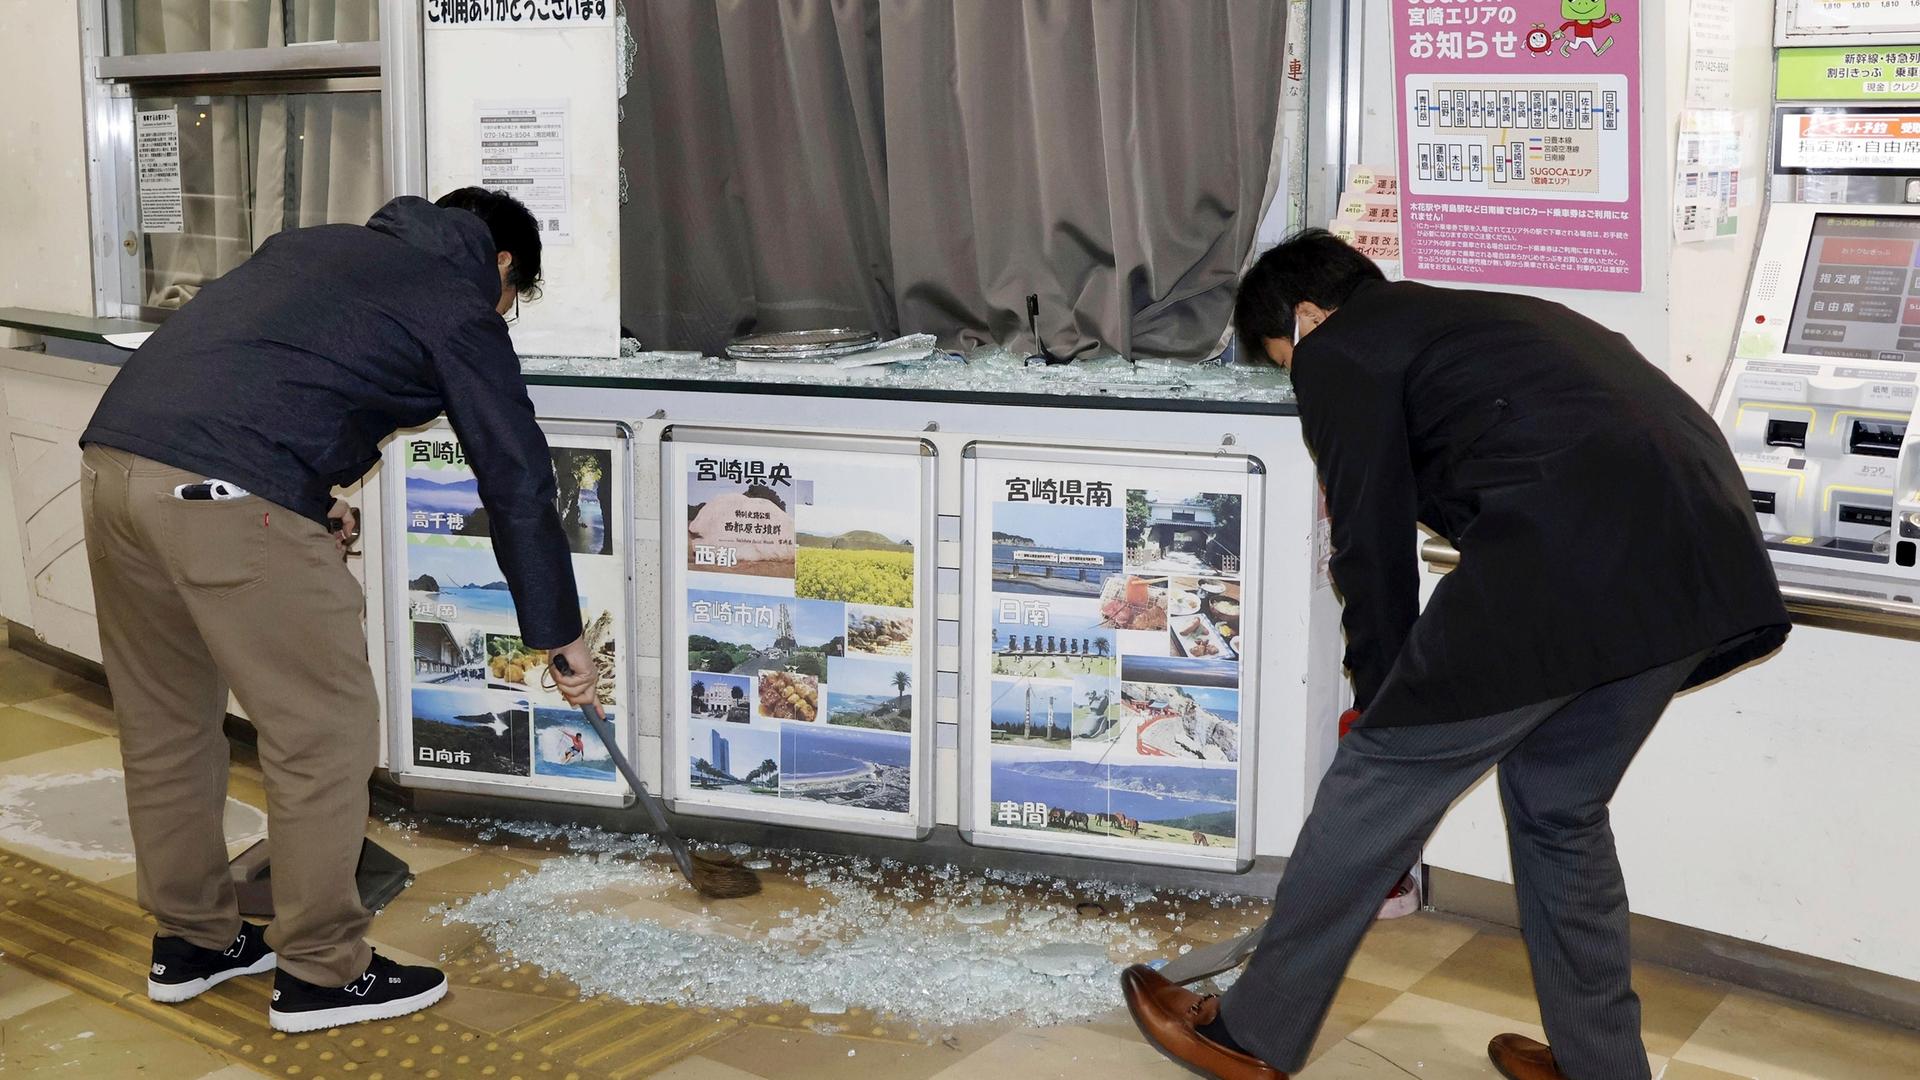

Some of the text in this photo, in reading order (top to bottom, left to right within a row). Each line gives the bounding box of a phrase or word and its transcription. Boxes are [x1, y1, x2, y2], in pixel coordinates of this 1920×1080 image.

[1408, 7, 1517, 26] 宮崎エリアの
[1409, 31, 1518, 59] お知らせ
[1827, 67, 1882, 79] 割引きっぷ
[1867, 83, 1885, 91] 現金
[1441, 100, 1450, 118] 田野
[1502, 97, 1511, 122] 南宮崎
[1517, 101, 1526, 119] 宮崎
[1532, 92, 1542, 127] 宮崎神宮
[1565, 93, 1574, 128] 日向住吉
[1580, 97, 1590, 124] 佐土原
[1605, 93, 1615, 128] 日向新富
[1544, 136, 1573, 144] 日豊本線
[1544, 145, 1580, 153] 宮崎空港線
[1420, 153, 1429, 171] 青島
[1436, 146, 1444, 179] 運動公園
[1451, 155, 1461, 171] 木花
[1471, 155, 1480, 172] 南方
[1496, 155, 1504, 172] 田吉
[1513, 144, 1523, 178] 宮崎空港
[1530, 167, 1592, 178] SUGOCAエリア
[1818, 273, 1861, 286] 指定席
[1813, 301, 1855, 313] 自由席
[694, 457, 793, 488] 宮崎県央
[1005, 476, 1113, 507] 宮崎県南
[411, 510, 465, 534] 高千穂
[694, 544, 737, 568] 西都
[415, 601, 458, 622] 延岡
[691, 599, 775, 629] 宮崎市内
[998, 597, 1051, 628] 日南
[418, 745, 472, 766] 日向市
[997, 800, 1049, 829] 串間
